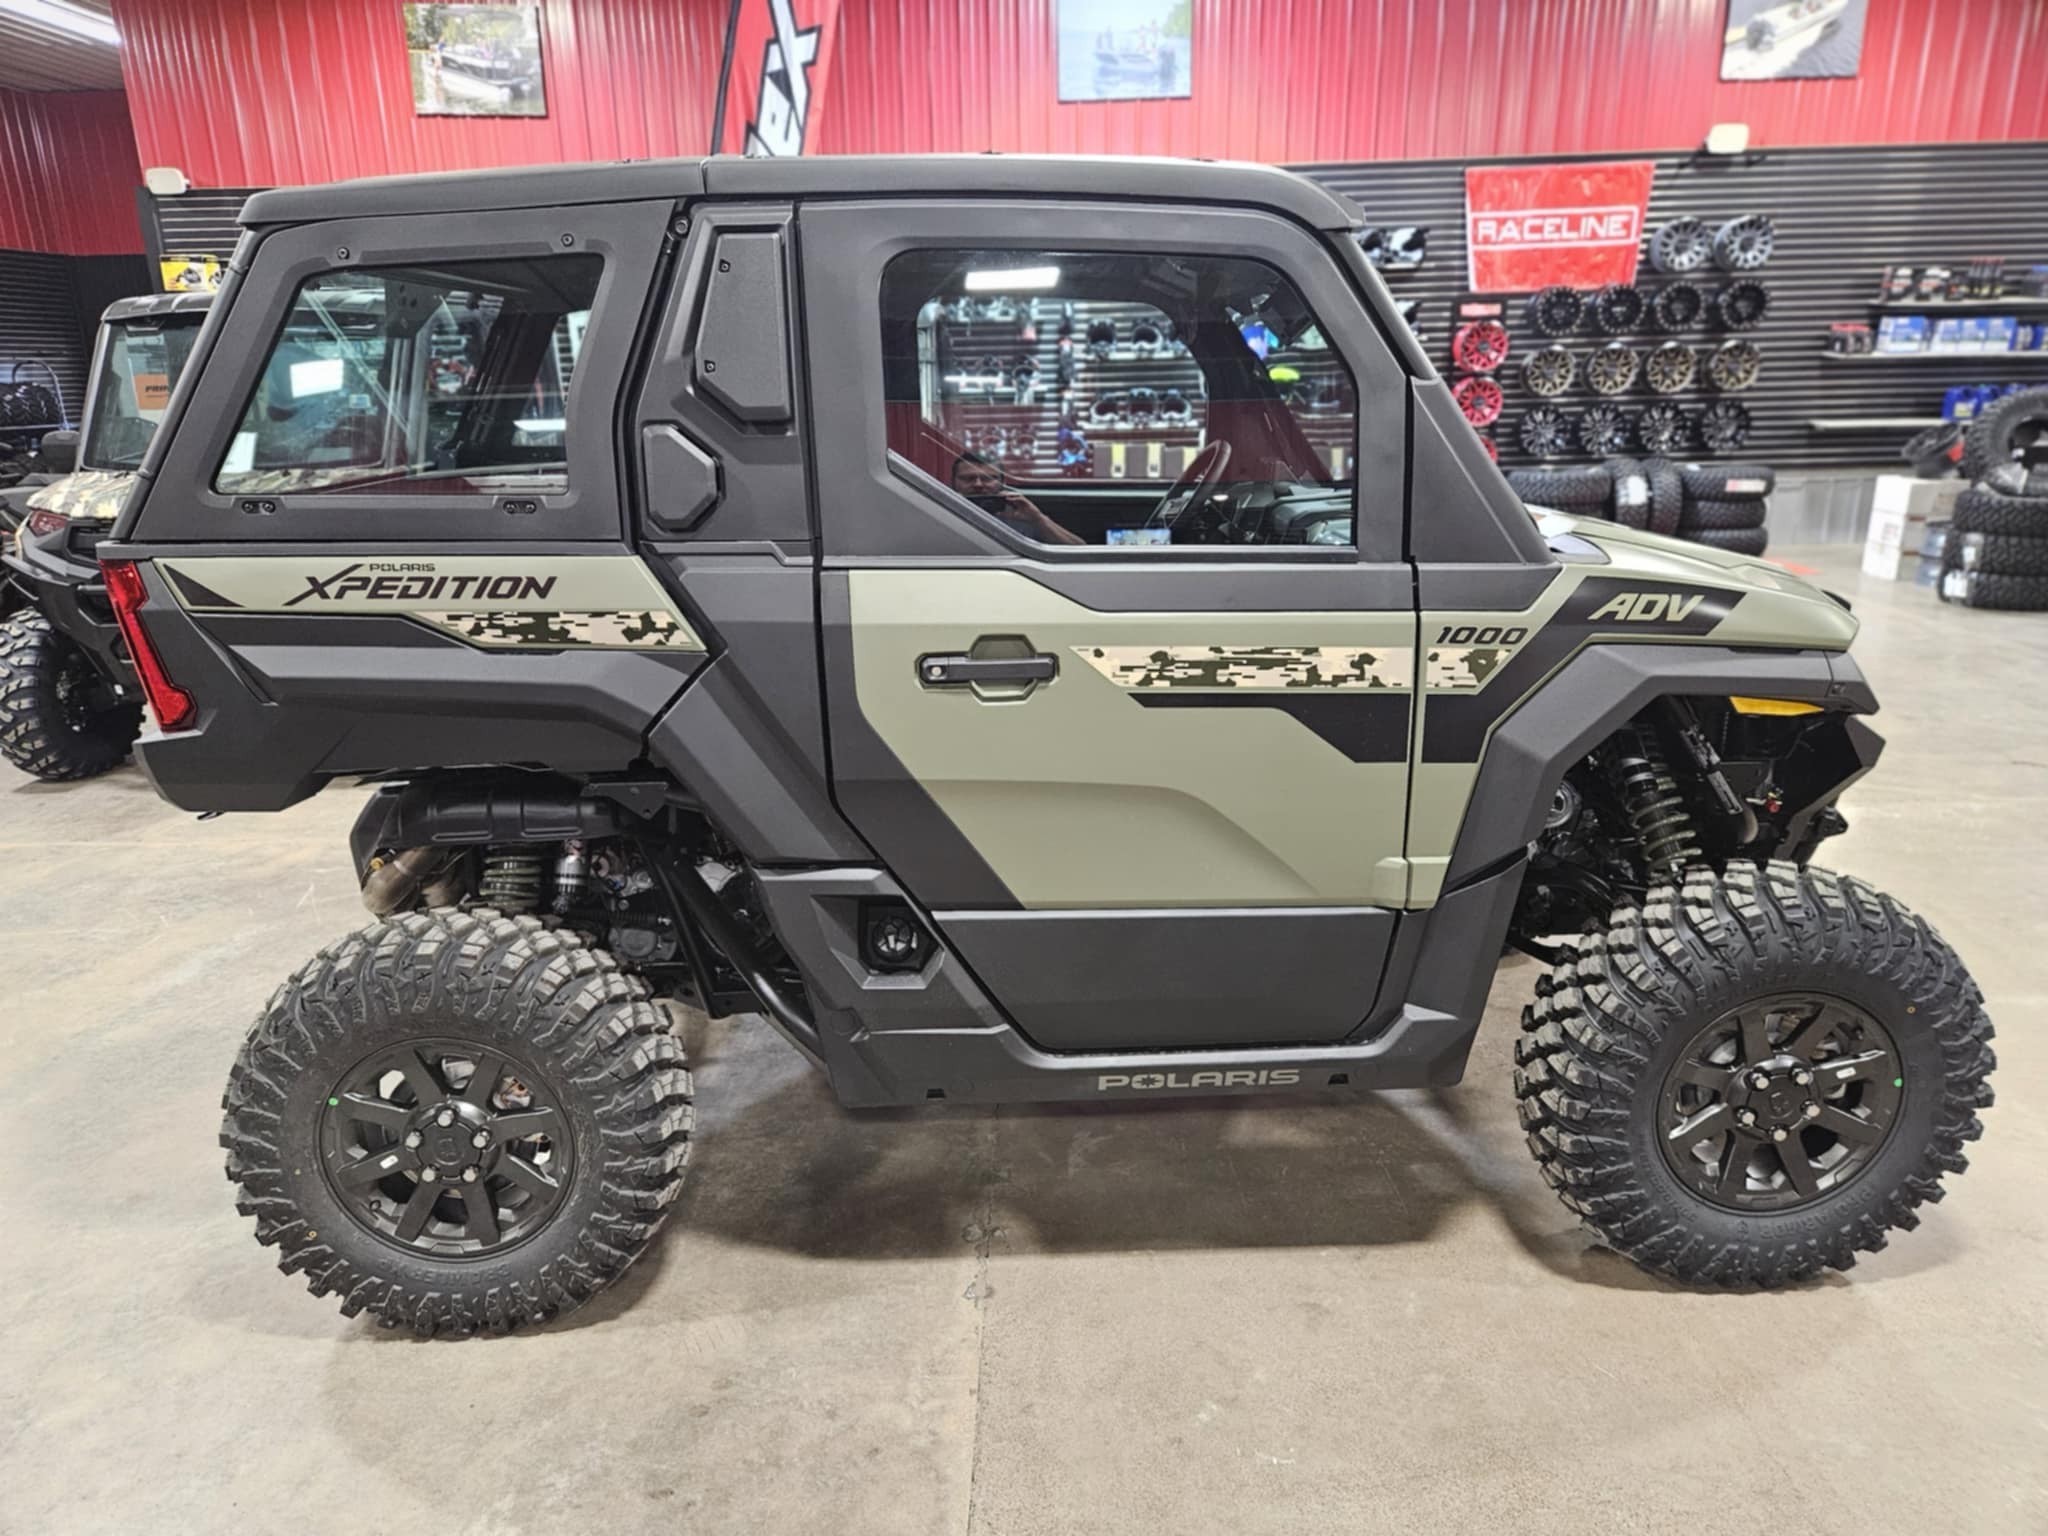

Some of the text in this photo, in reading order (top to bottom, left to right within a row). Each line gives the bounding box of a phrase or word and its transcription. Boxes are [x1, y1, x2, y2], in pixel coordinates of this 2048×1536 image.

[1477, 213, 1631, 242] RACELINE
[369, 563, 436, 572] POLARIS
[282, 563, 557, 607] XPEDITION
[1587, 592, 1705, 622] ADV
[1436, 626, 1529, 645] 1000
[1097, 1069, 1300, 1091] POLARIS
